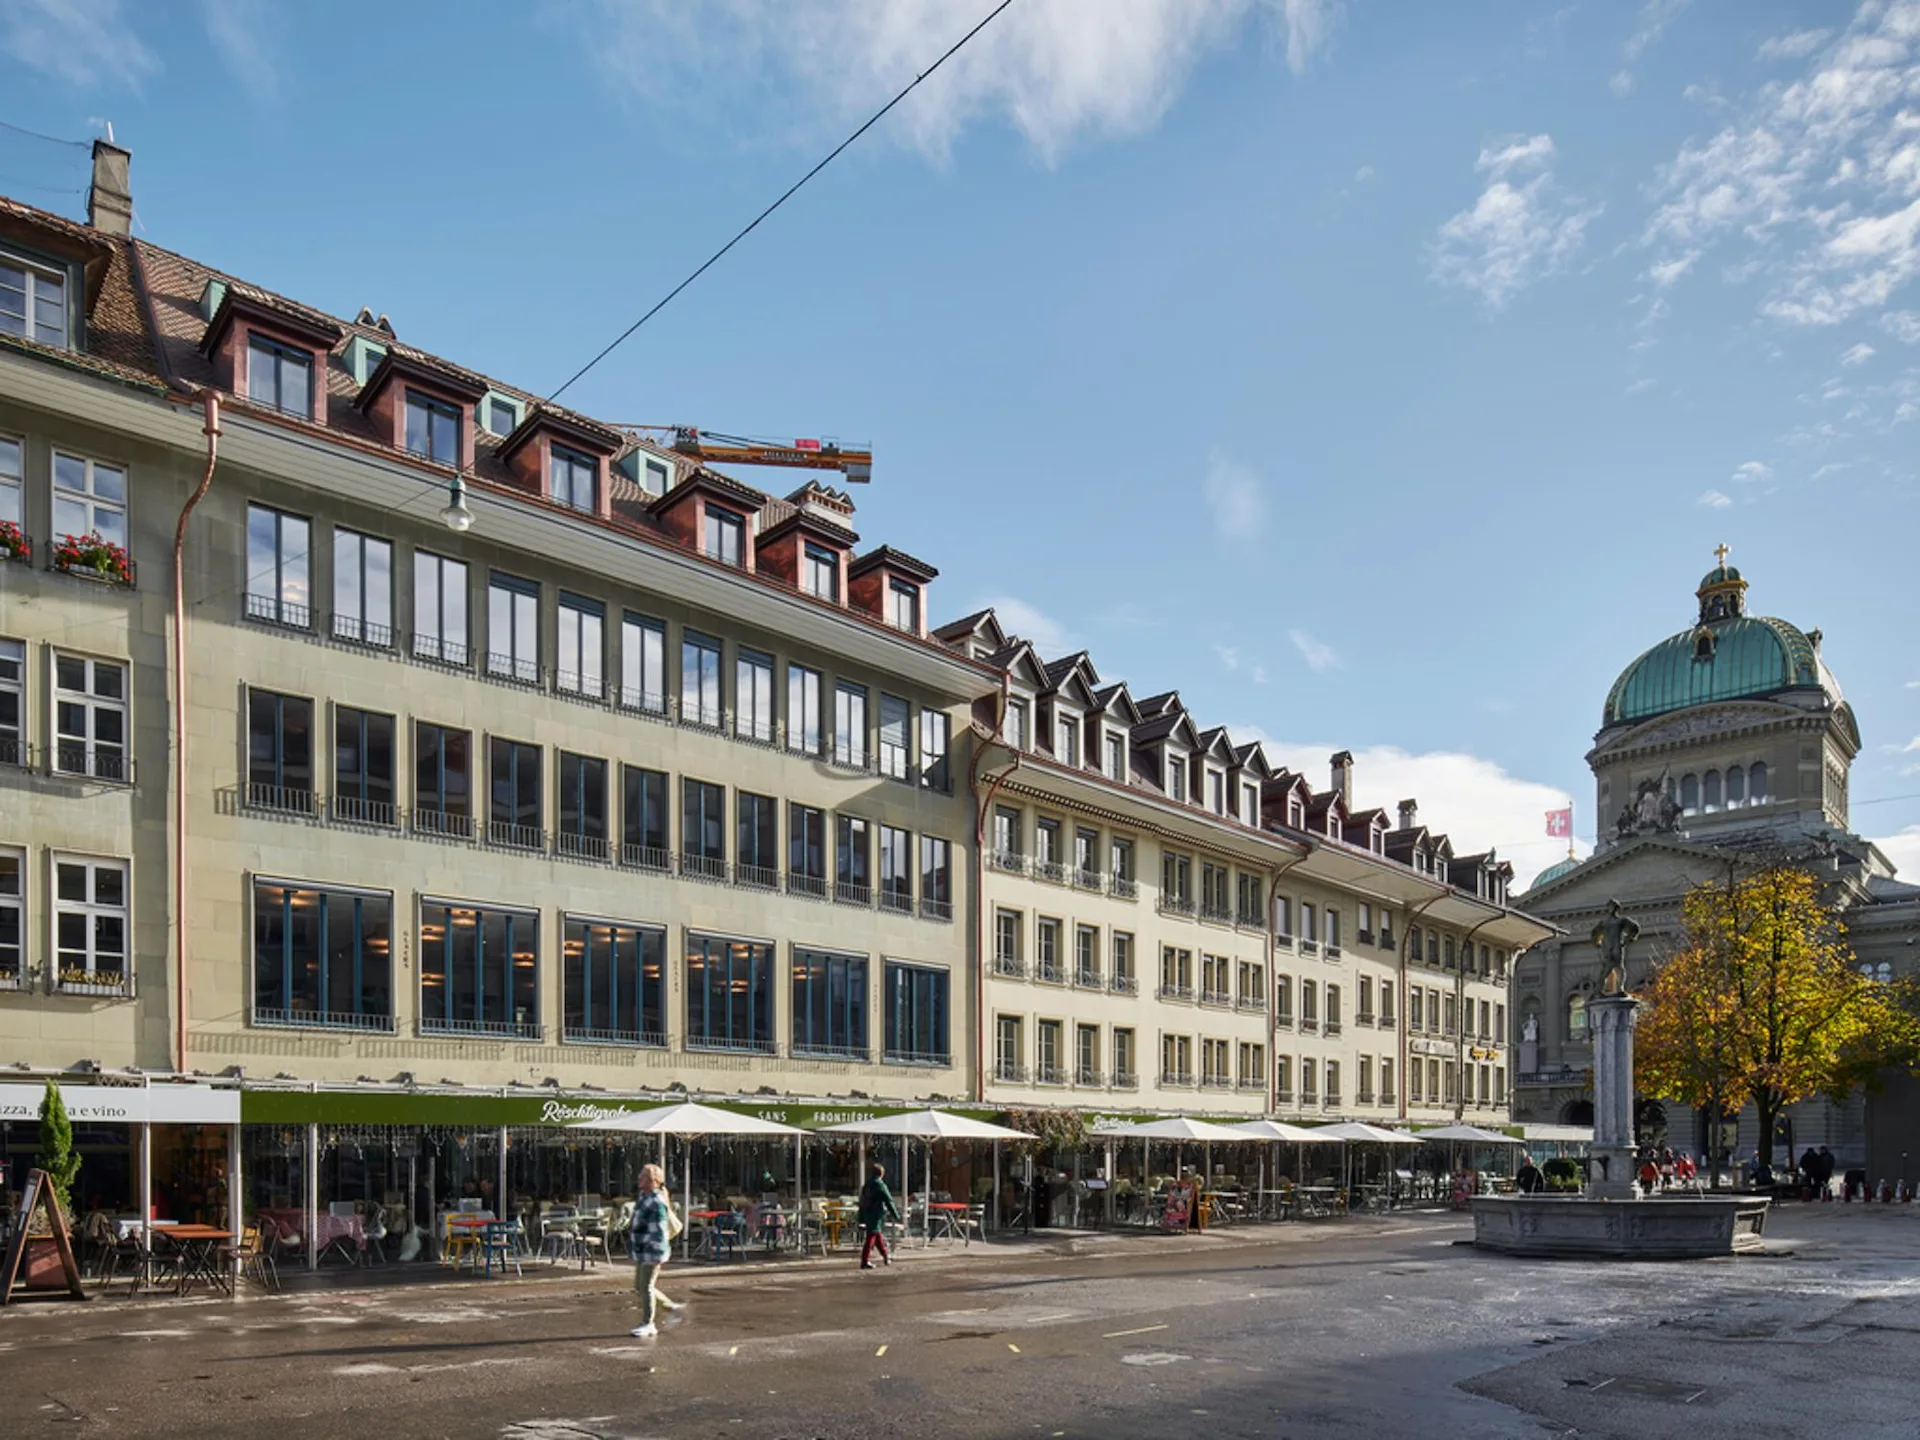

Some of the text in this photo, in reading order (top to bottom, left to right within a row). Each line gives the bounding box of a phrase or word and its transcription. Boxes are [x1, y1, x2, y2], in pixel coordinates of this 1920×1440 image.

[0, 1105, 33, 1117] izza,
[79, 1106, 89, 1117] e
[92, 1105, 127, 1117] vino
[758, 1106, 787, 1122] SANS
